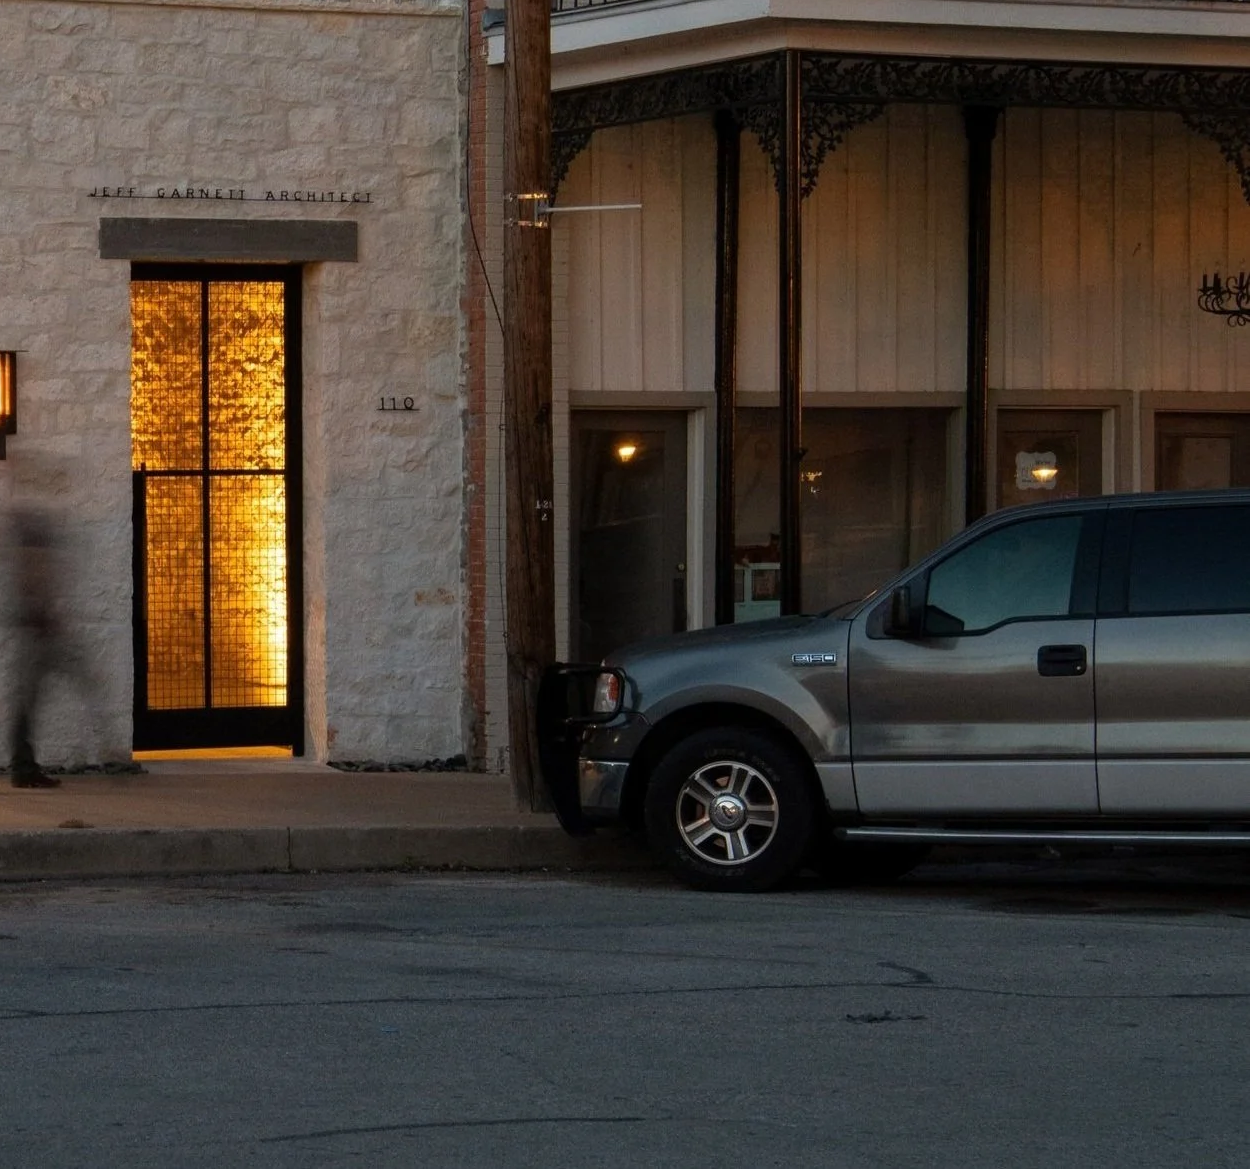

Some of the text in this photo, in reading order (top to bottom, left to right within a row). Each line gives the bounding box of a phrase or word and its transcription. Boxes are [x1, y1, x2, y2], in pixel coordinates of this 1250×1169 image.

[89, 186, 373, 203] JEFF GARNETT ARCHITECT
[379, 396, 415, 410] 110
